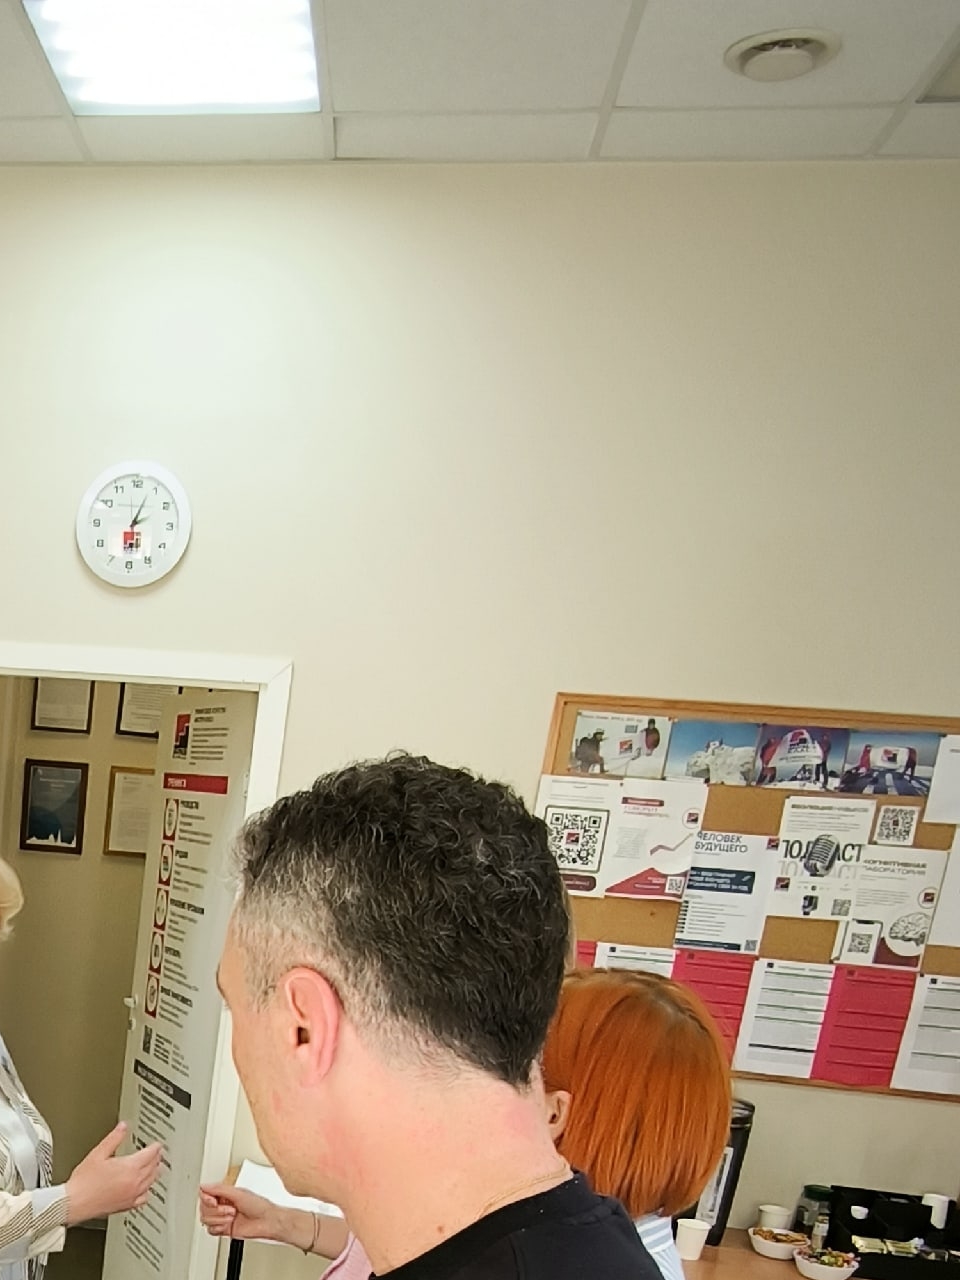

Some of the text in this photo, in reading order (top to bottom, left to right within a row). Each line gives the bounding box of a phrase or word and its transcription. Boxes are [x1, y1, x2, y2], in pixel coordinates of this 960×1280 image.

[131, 479, 144, 489] 12
[114, 485, 124, 494] 11
[153, 486, 158, 495] 1
[162, 501, 170, 511] 2
[93, 518, 101, 528] 9
[166, 522, 174, 531] 3
[96, 539, 104, 548] 8
[106, 554, 116, 566] 7
[125, 560, 133, 570] 6
[144, 555, 152, 565] 5
[697, 831, 743, 844] ЧЕЛОВЕК
[695, 841, 748, 854] БУДУЩЕГО
